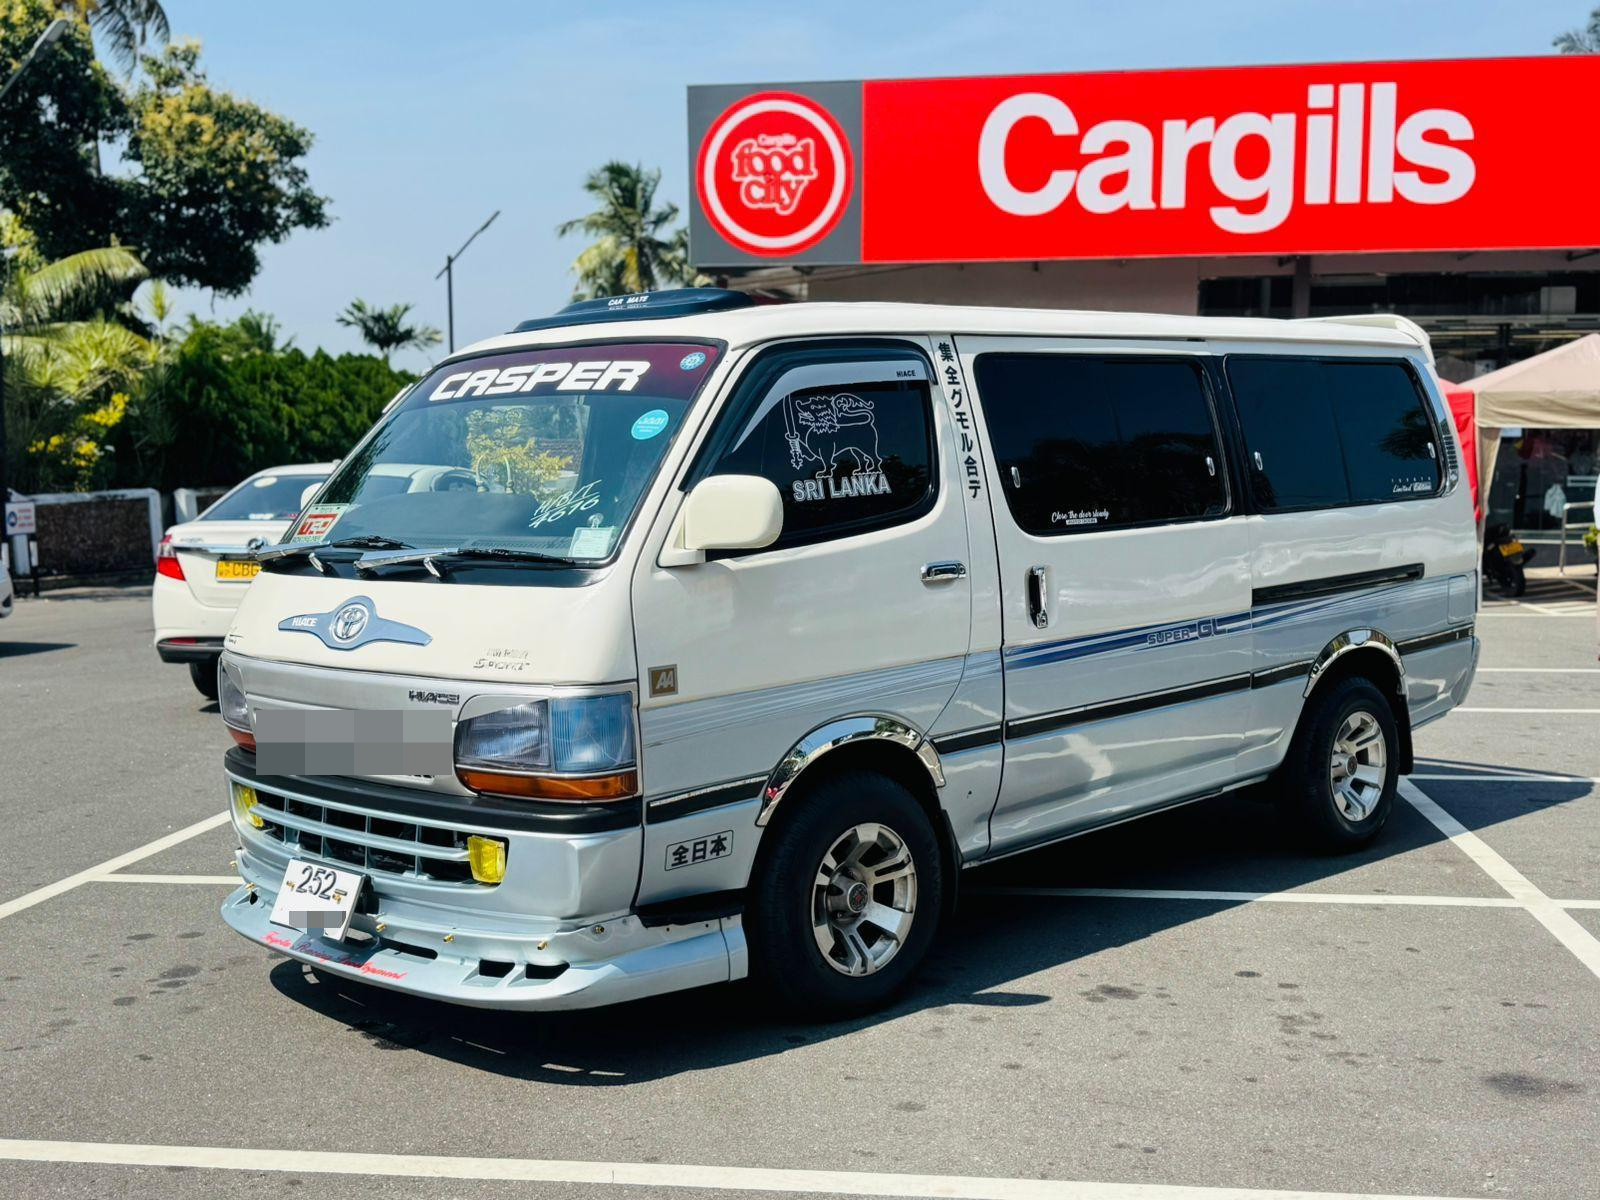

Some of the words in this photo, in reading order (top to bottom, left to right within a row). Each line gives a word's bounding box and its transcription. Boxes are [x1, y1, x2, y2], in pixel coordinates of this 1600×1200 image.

[733, 140, 816, 180] food
[977, 81, 1477, 234] Cargills
[742, 175, 807, 214] city
[607, 298, 624, 307] CAR
[626, 295, 650, 304] MATE
[428, 360, 651, 402] CASPER
[895, 369, 917, 378] HIACE
[792, 477, 825, 502] SRI
[828, 473, 892, 499] LANKA
[292, 617, 318, 627] HIACE
[1147, 627, 1190, 645] SUPER
[1197, 618, 1228, 639] GL
[408, 690, 460, 705] HIACE
[671, 835, 728, 867] 全日本
